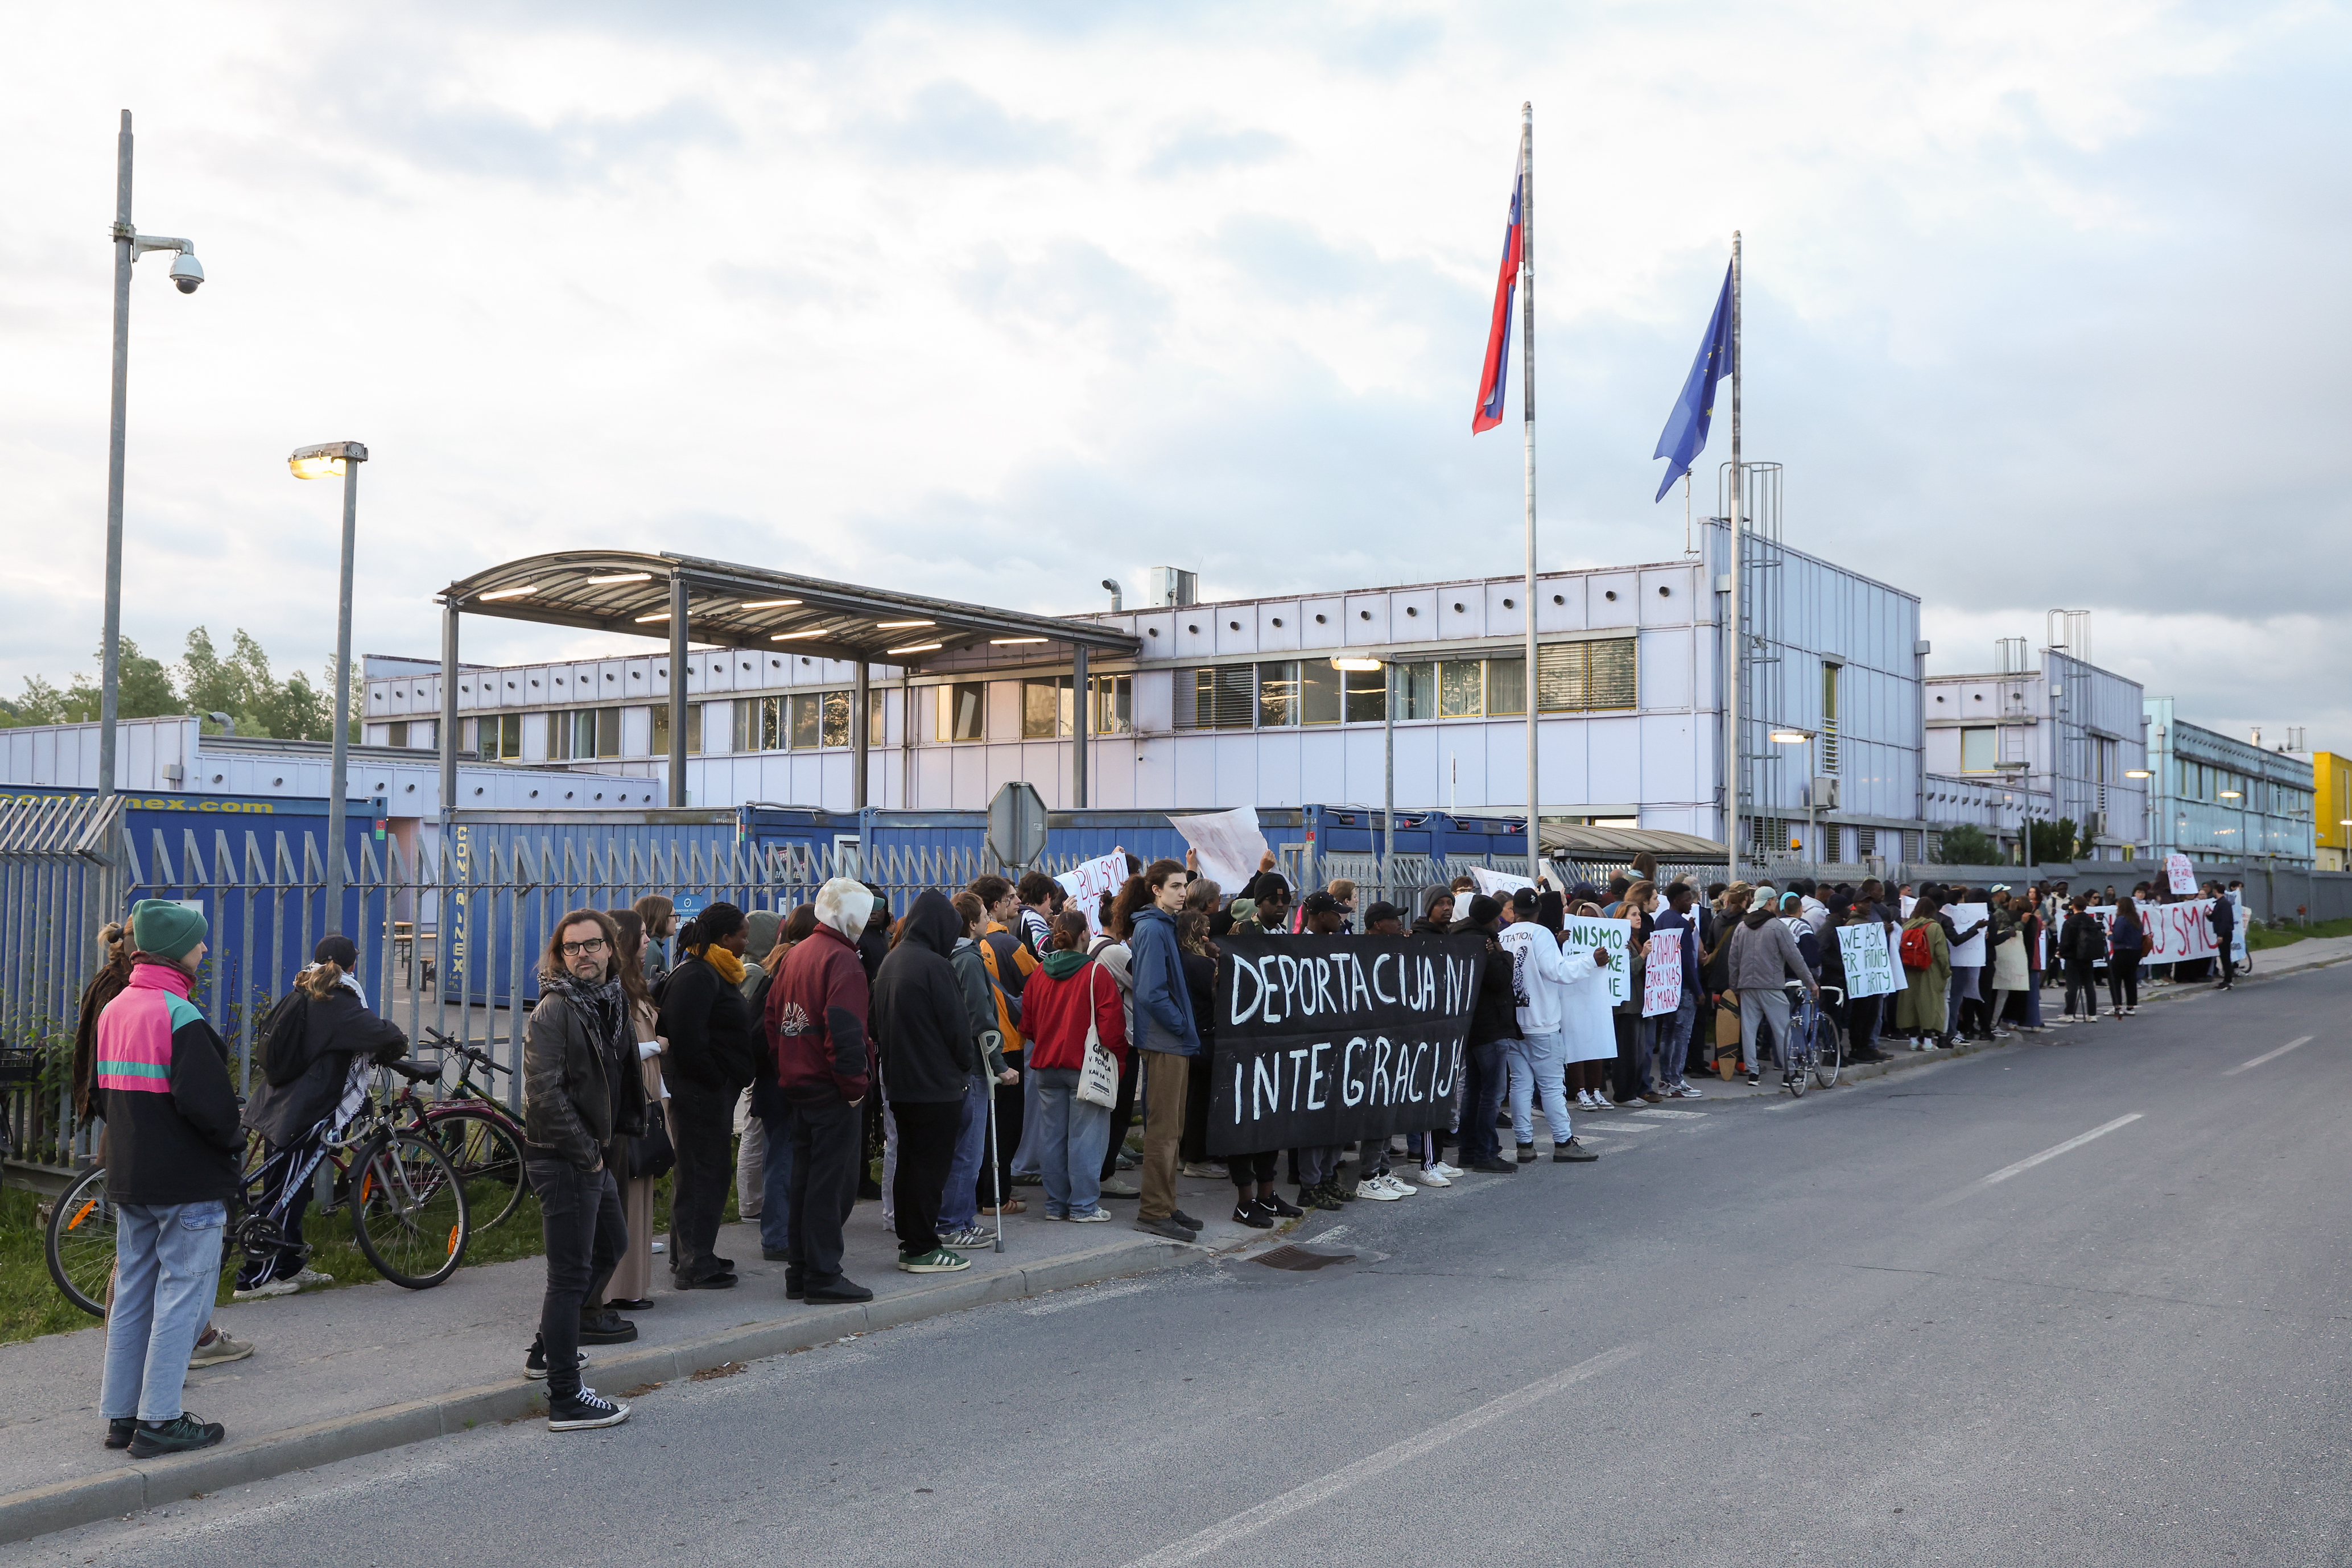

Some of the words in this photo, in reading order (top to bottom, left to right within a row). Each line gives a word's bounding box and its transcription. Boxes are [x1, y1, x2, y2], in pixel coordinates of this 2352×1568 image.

[1101, 857, 1124, 890] SMO
[1499, 931, 1534, 943] UTATION
[1573, 925, 1622, 950] NISMO
[1839, 927, 1862, 948] WE
[1866, 922, 1882, 947] ASK
[1842, 952, 1858, 972] FOR
[1231, 952, 1436, 1025] DEPORTACIJA
[1446, 953, 1475, 1016] NI
[1646, 969, 1664, 989] ZAKAJ
[1645, 990, 1654, 1013] NE
[1657, 987, 1679, 1010] MARAŠ
[1235, 1035, 1464, 1125] INTEGRACIJA
[281, 1149, 326, 1208] MERIDA
